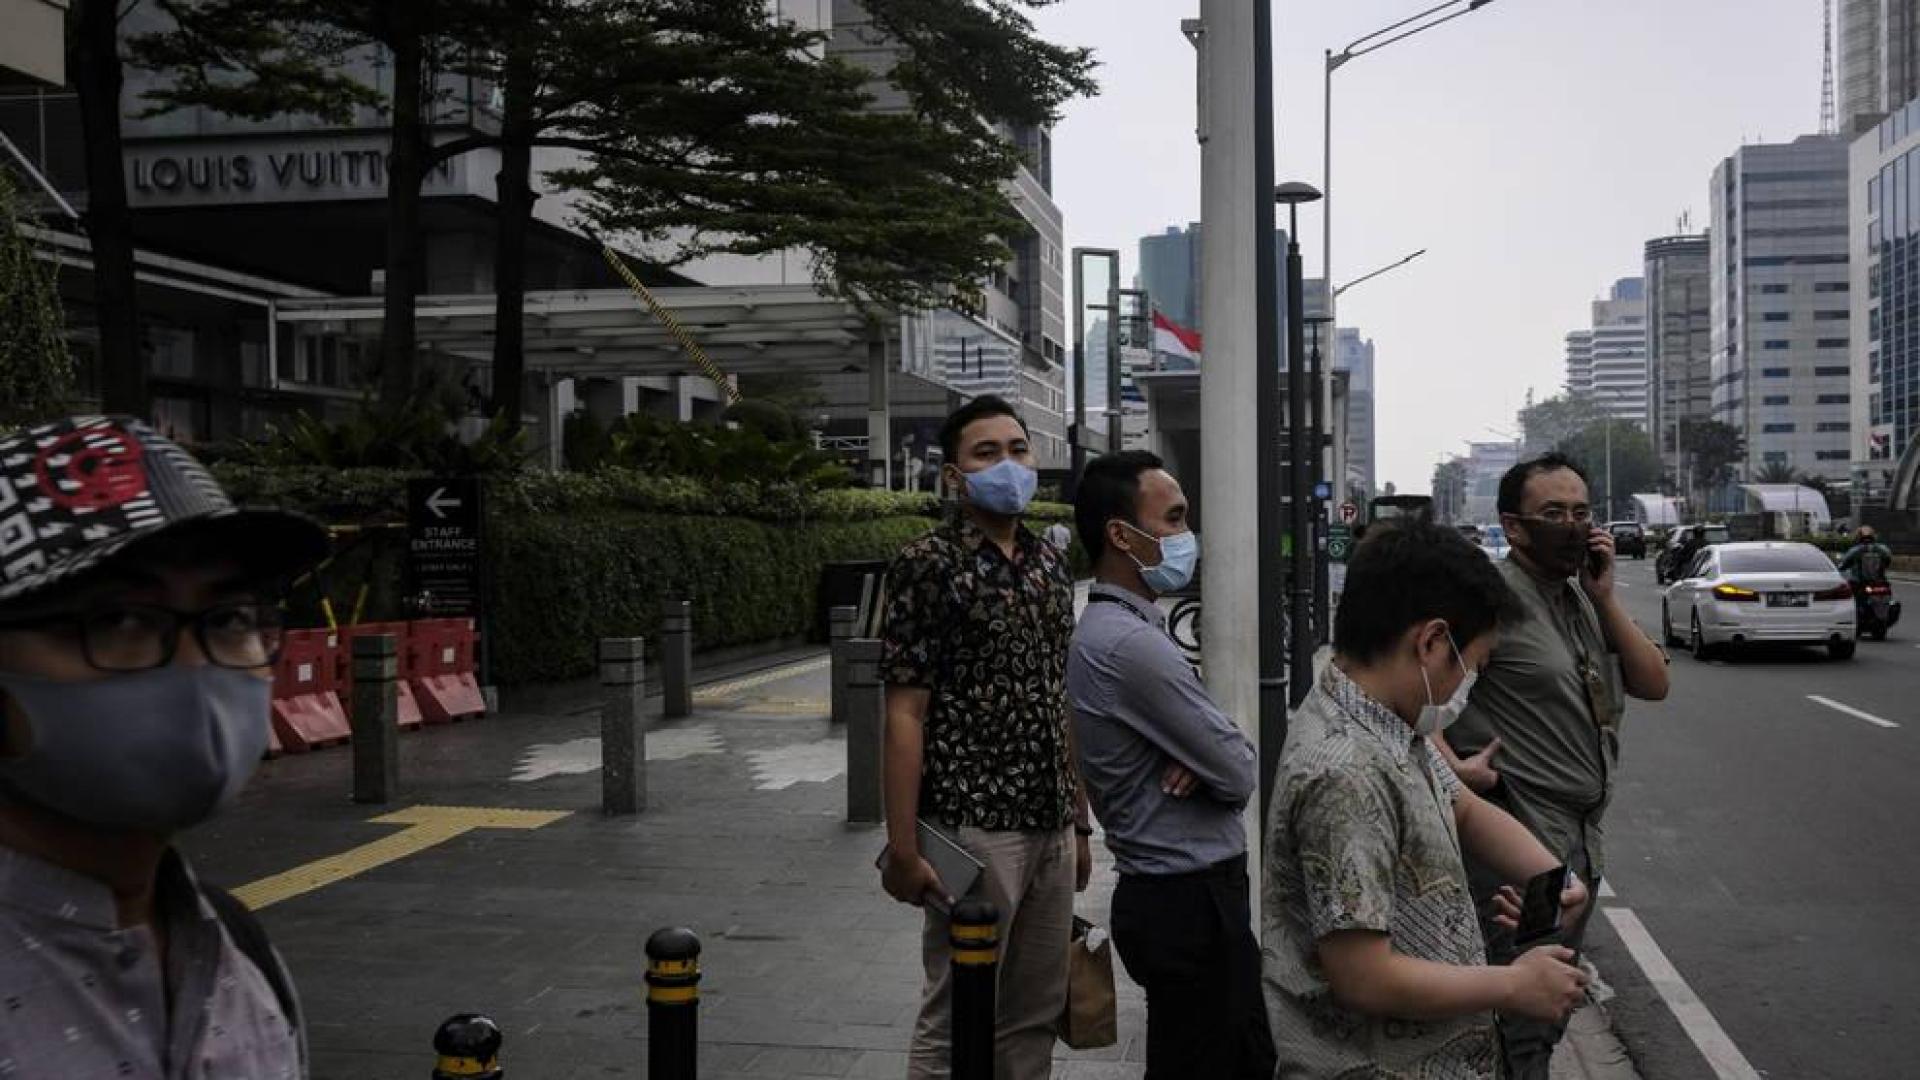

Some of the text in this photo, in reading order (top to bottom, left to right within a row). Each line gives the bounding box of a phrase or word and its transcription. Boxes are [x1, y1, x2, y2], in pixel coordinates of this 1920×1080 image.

[133, 149, 455, 192] LOUIS VUITTN
[423, 526, 461, 537] STAFF
[411, 538, 477, 551] ENTRANCE
